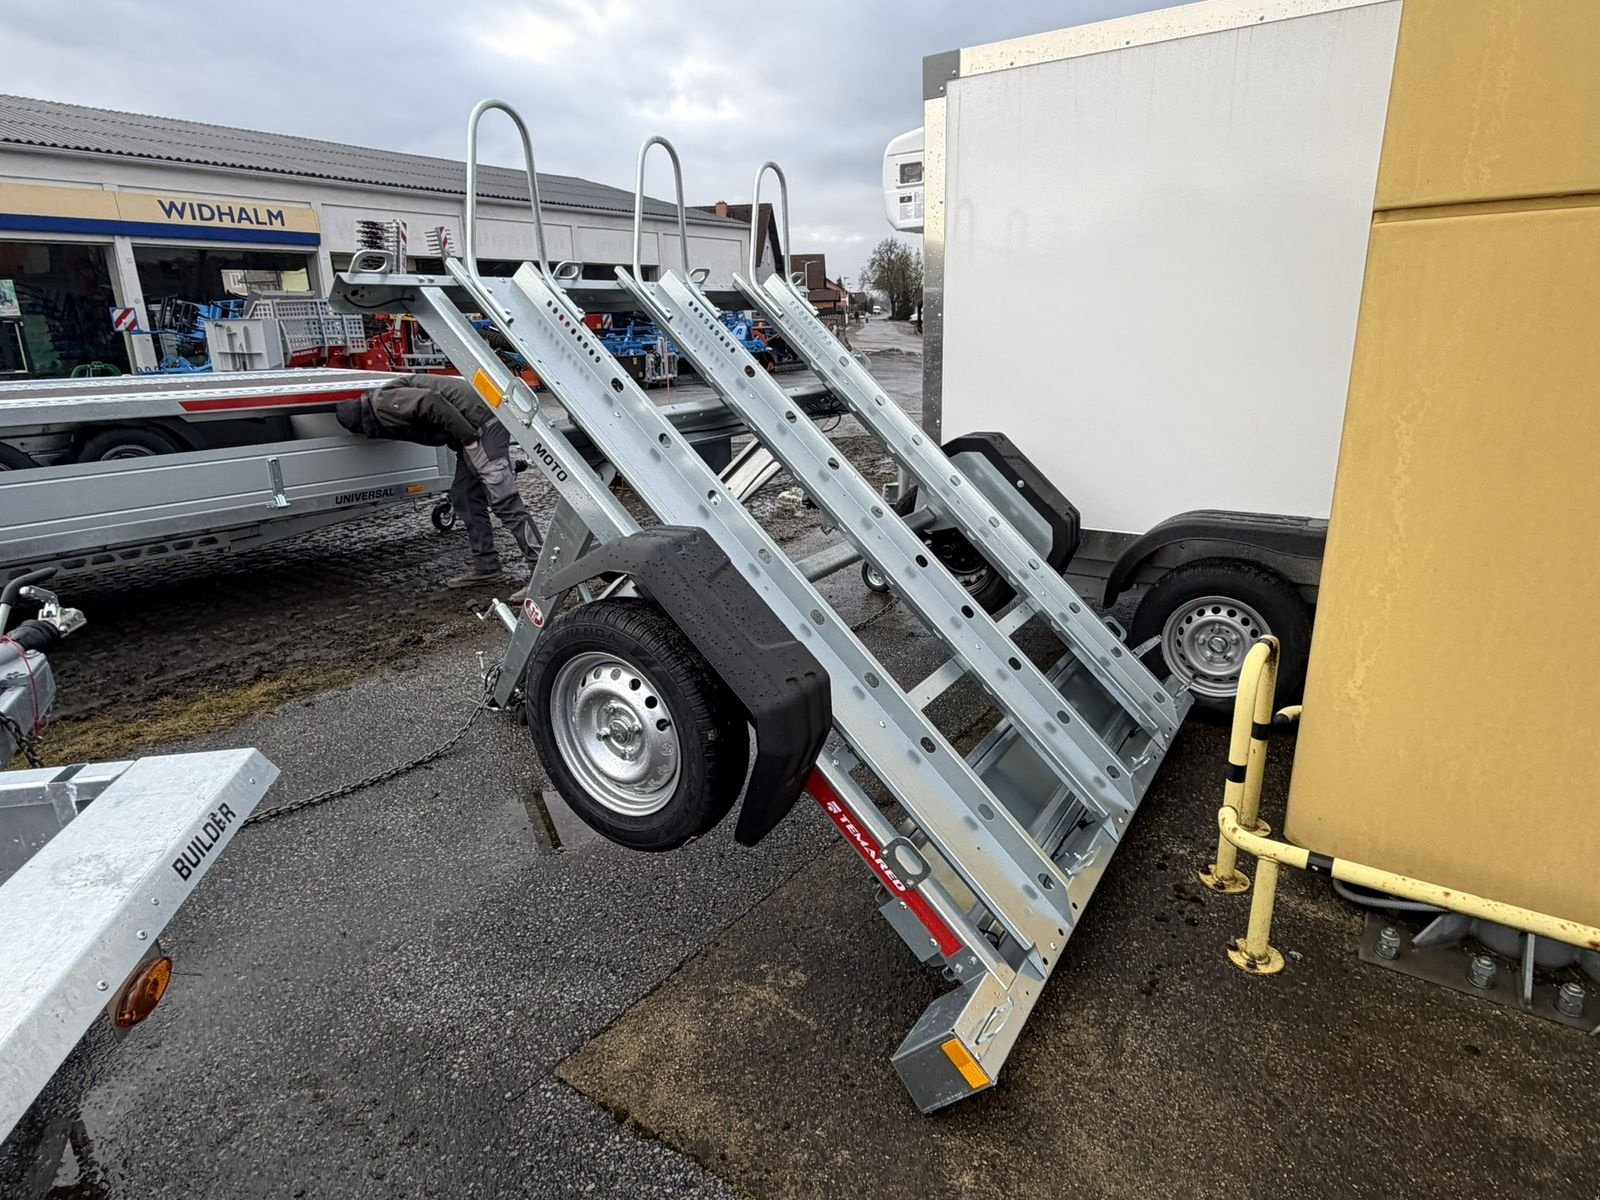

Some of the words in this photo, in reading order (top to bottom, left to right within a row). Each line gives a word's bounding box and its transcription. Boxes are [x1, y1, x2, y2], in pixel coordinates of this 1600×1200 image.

[157, 199, 286, 227] WIDHALM
[533, 442, 568, 482] MOTO
[335, 488, 395, 505] UNIVERSAL
[171, 802, 237, 881] BUILDER
[839, 813, 907, 892] TEMARED
